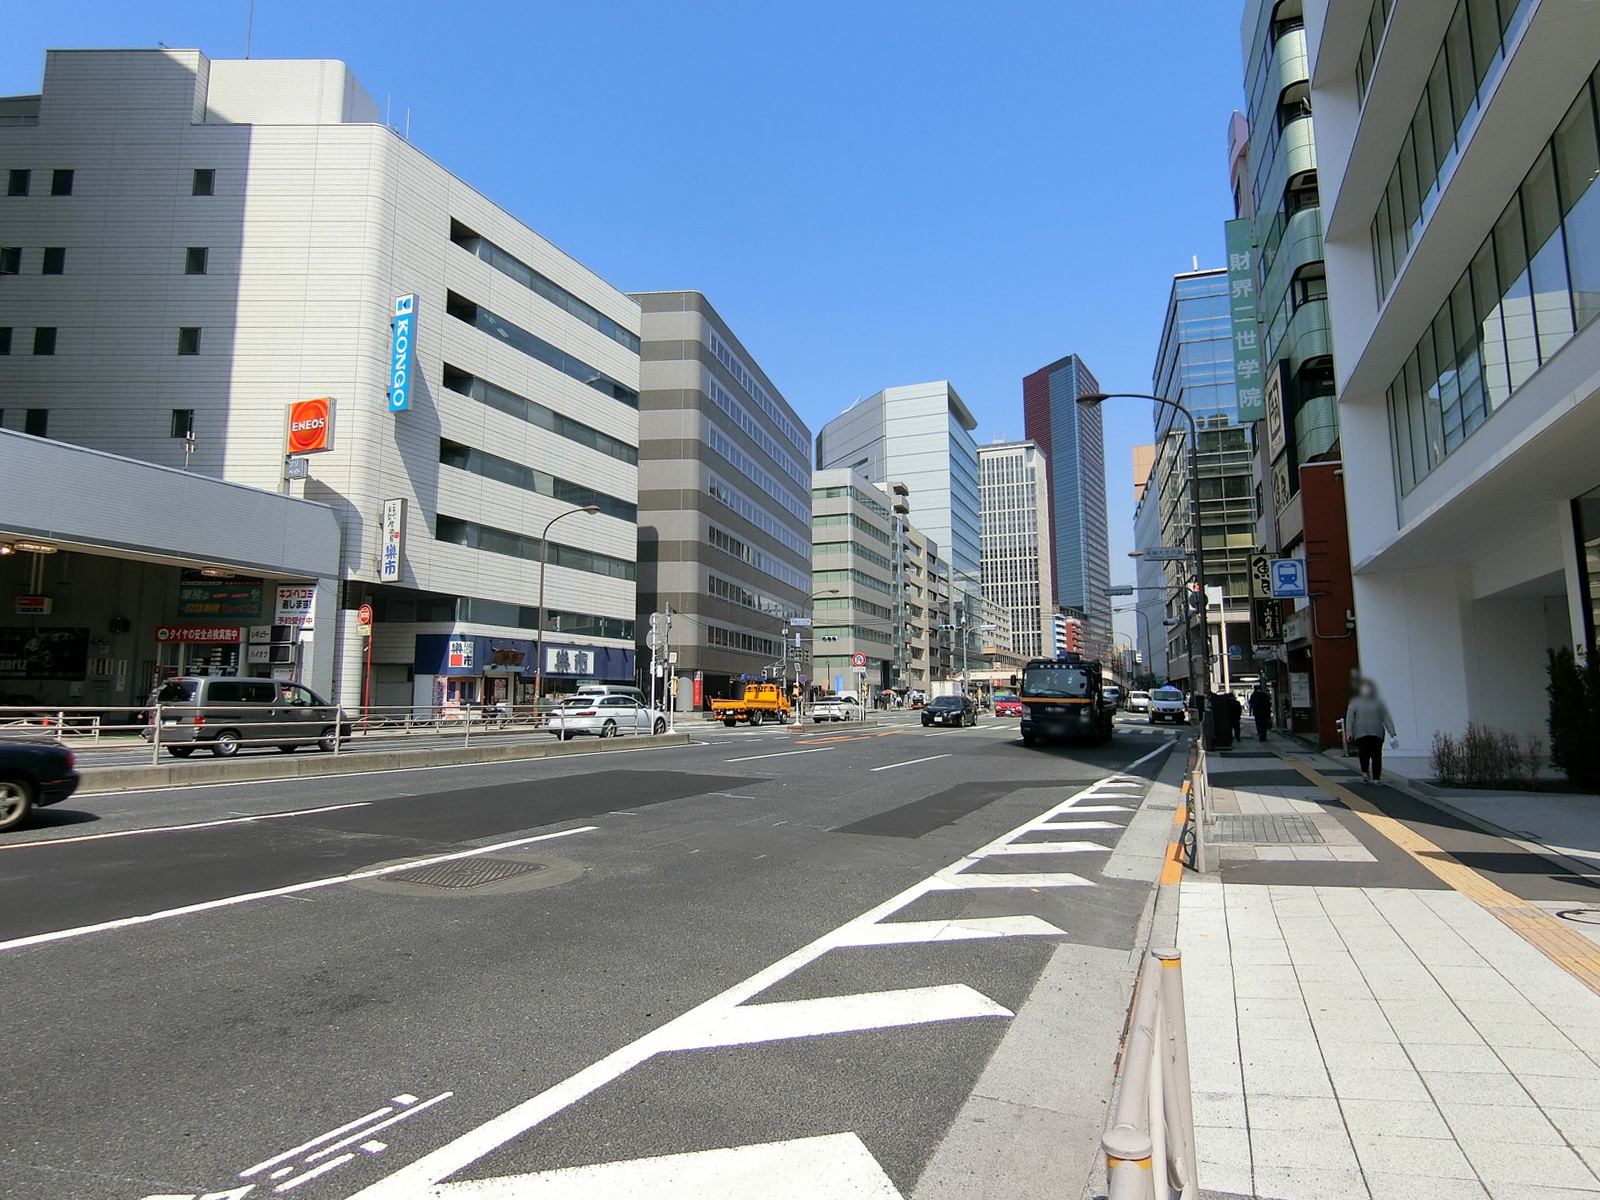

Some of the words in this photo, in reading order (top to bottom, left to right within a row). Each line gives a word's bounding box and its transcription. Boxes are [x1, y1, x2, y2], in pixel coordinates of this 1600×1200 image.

[1230, 253, 1262, 409] 財界二世学院
[393, 318, 409, 406] KONGO
[292, 418, 325, 432] ENEOS
[277, 616, 313, 625] 予約受付中
[169, 629, 238, 640] タイヤの安全点検実施中
[252, 631, 269, 639] レギュラー
